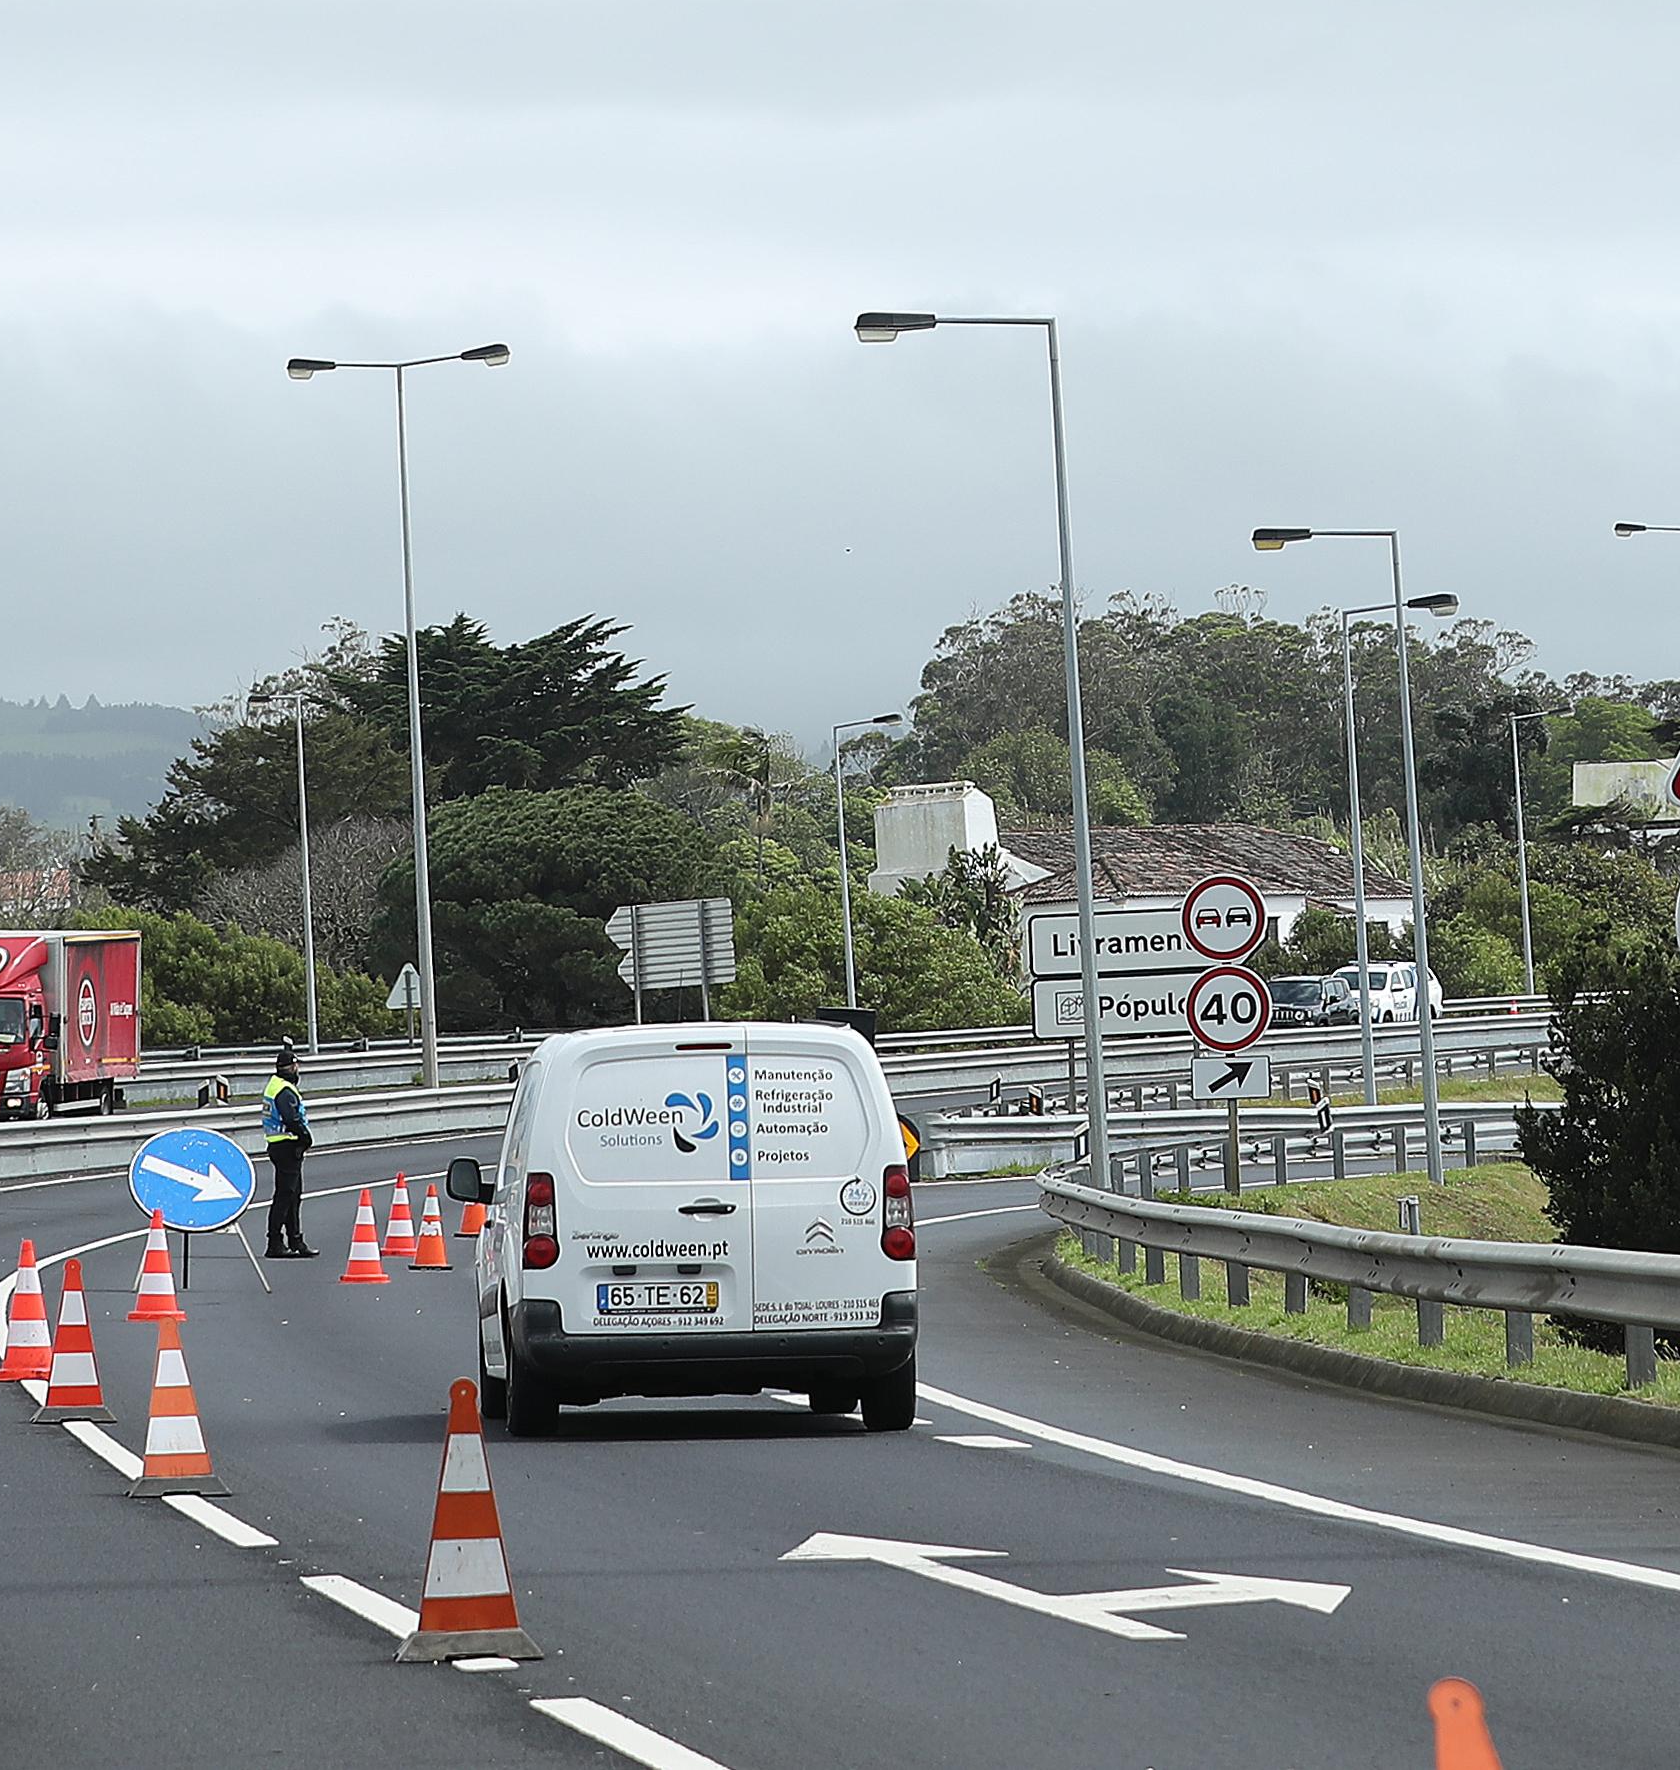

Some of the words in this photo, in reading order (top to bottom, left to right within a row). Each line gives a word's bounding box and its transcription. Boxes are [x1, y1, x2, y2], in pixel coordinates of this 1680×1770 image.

[1052, 932, 1193, 957] Liramen
[1200, 991, 1257, 1026] 40
[754, 1068, 833, 1083] Manutenção
[755, 1089, 833, 1103] Refrigeração
[763, 1102, 822, 1113] Industrial
[577, 1107, 683, 1128] ColdWeen
[755, 1122, 828, 1136] Automação
[600, 1133, 663, 1147] Solutions
[757, 1150, 810, 1163] Projetos
[586, 1239, 729, 1260] www.coldween.pt
[593, 1316, 639, 1328] DELEGAÇÃO
[640, 1316, 672, 1328] AÇORES
[753, 1312, 801, 1325] DELEGAÇÃO
[802, 1313, 828, 1322] NORTE
